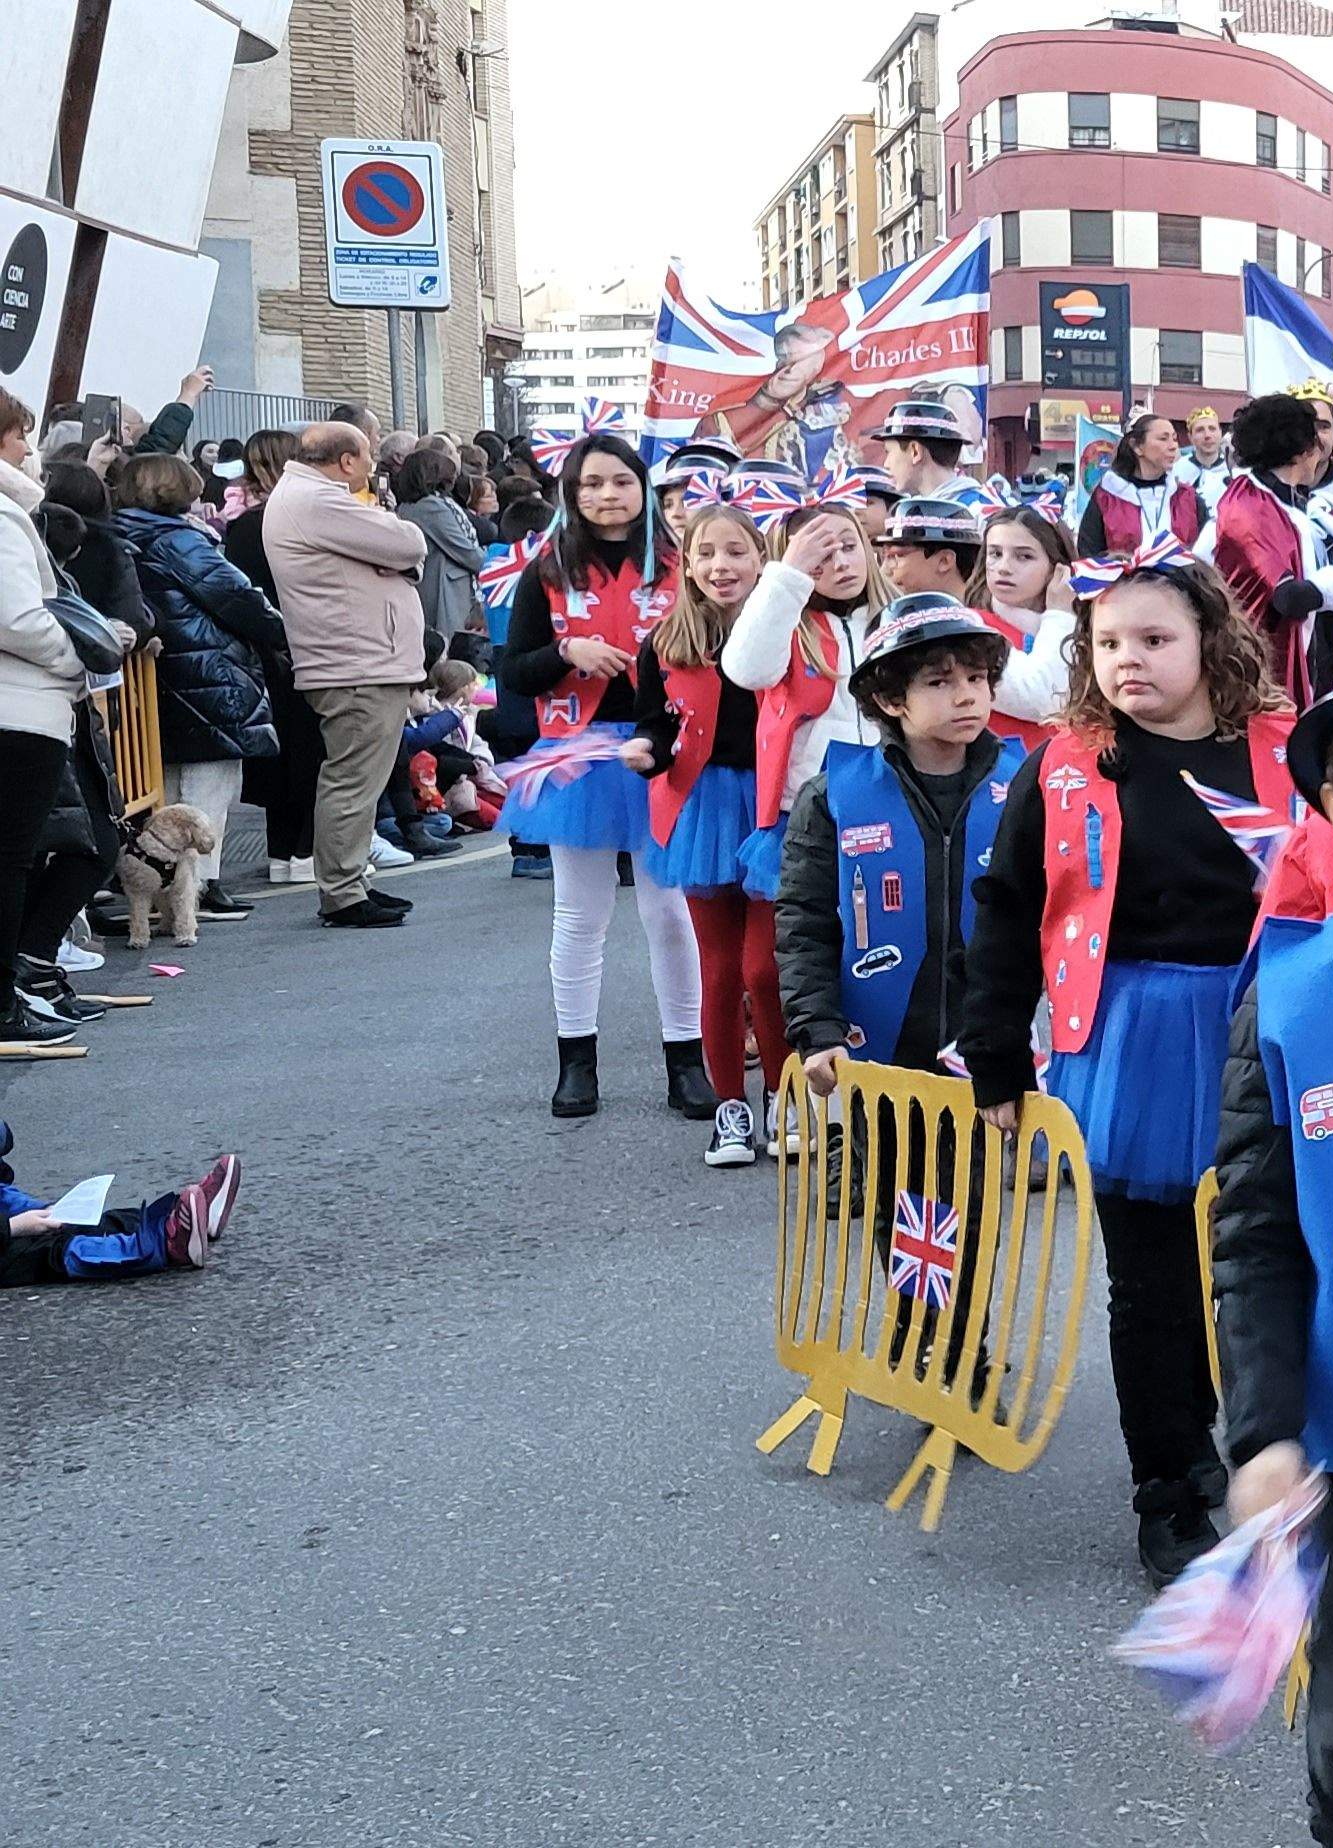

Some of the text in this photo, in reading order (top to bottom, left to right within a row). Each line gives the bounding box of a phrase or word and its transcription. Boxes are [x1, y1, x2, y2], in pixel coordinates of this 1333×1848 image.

[7, 264, 24, 282] CON
[1053, 327, 1107, 341] REPSOL
[648, 374, 716, 414] King
[850, 343, 942, 373] Charles
